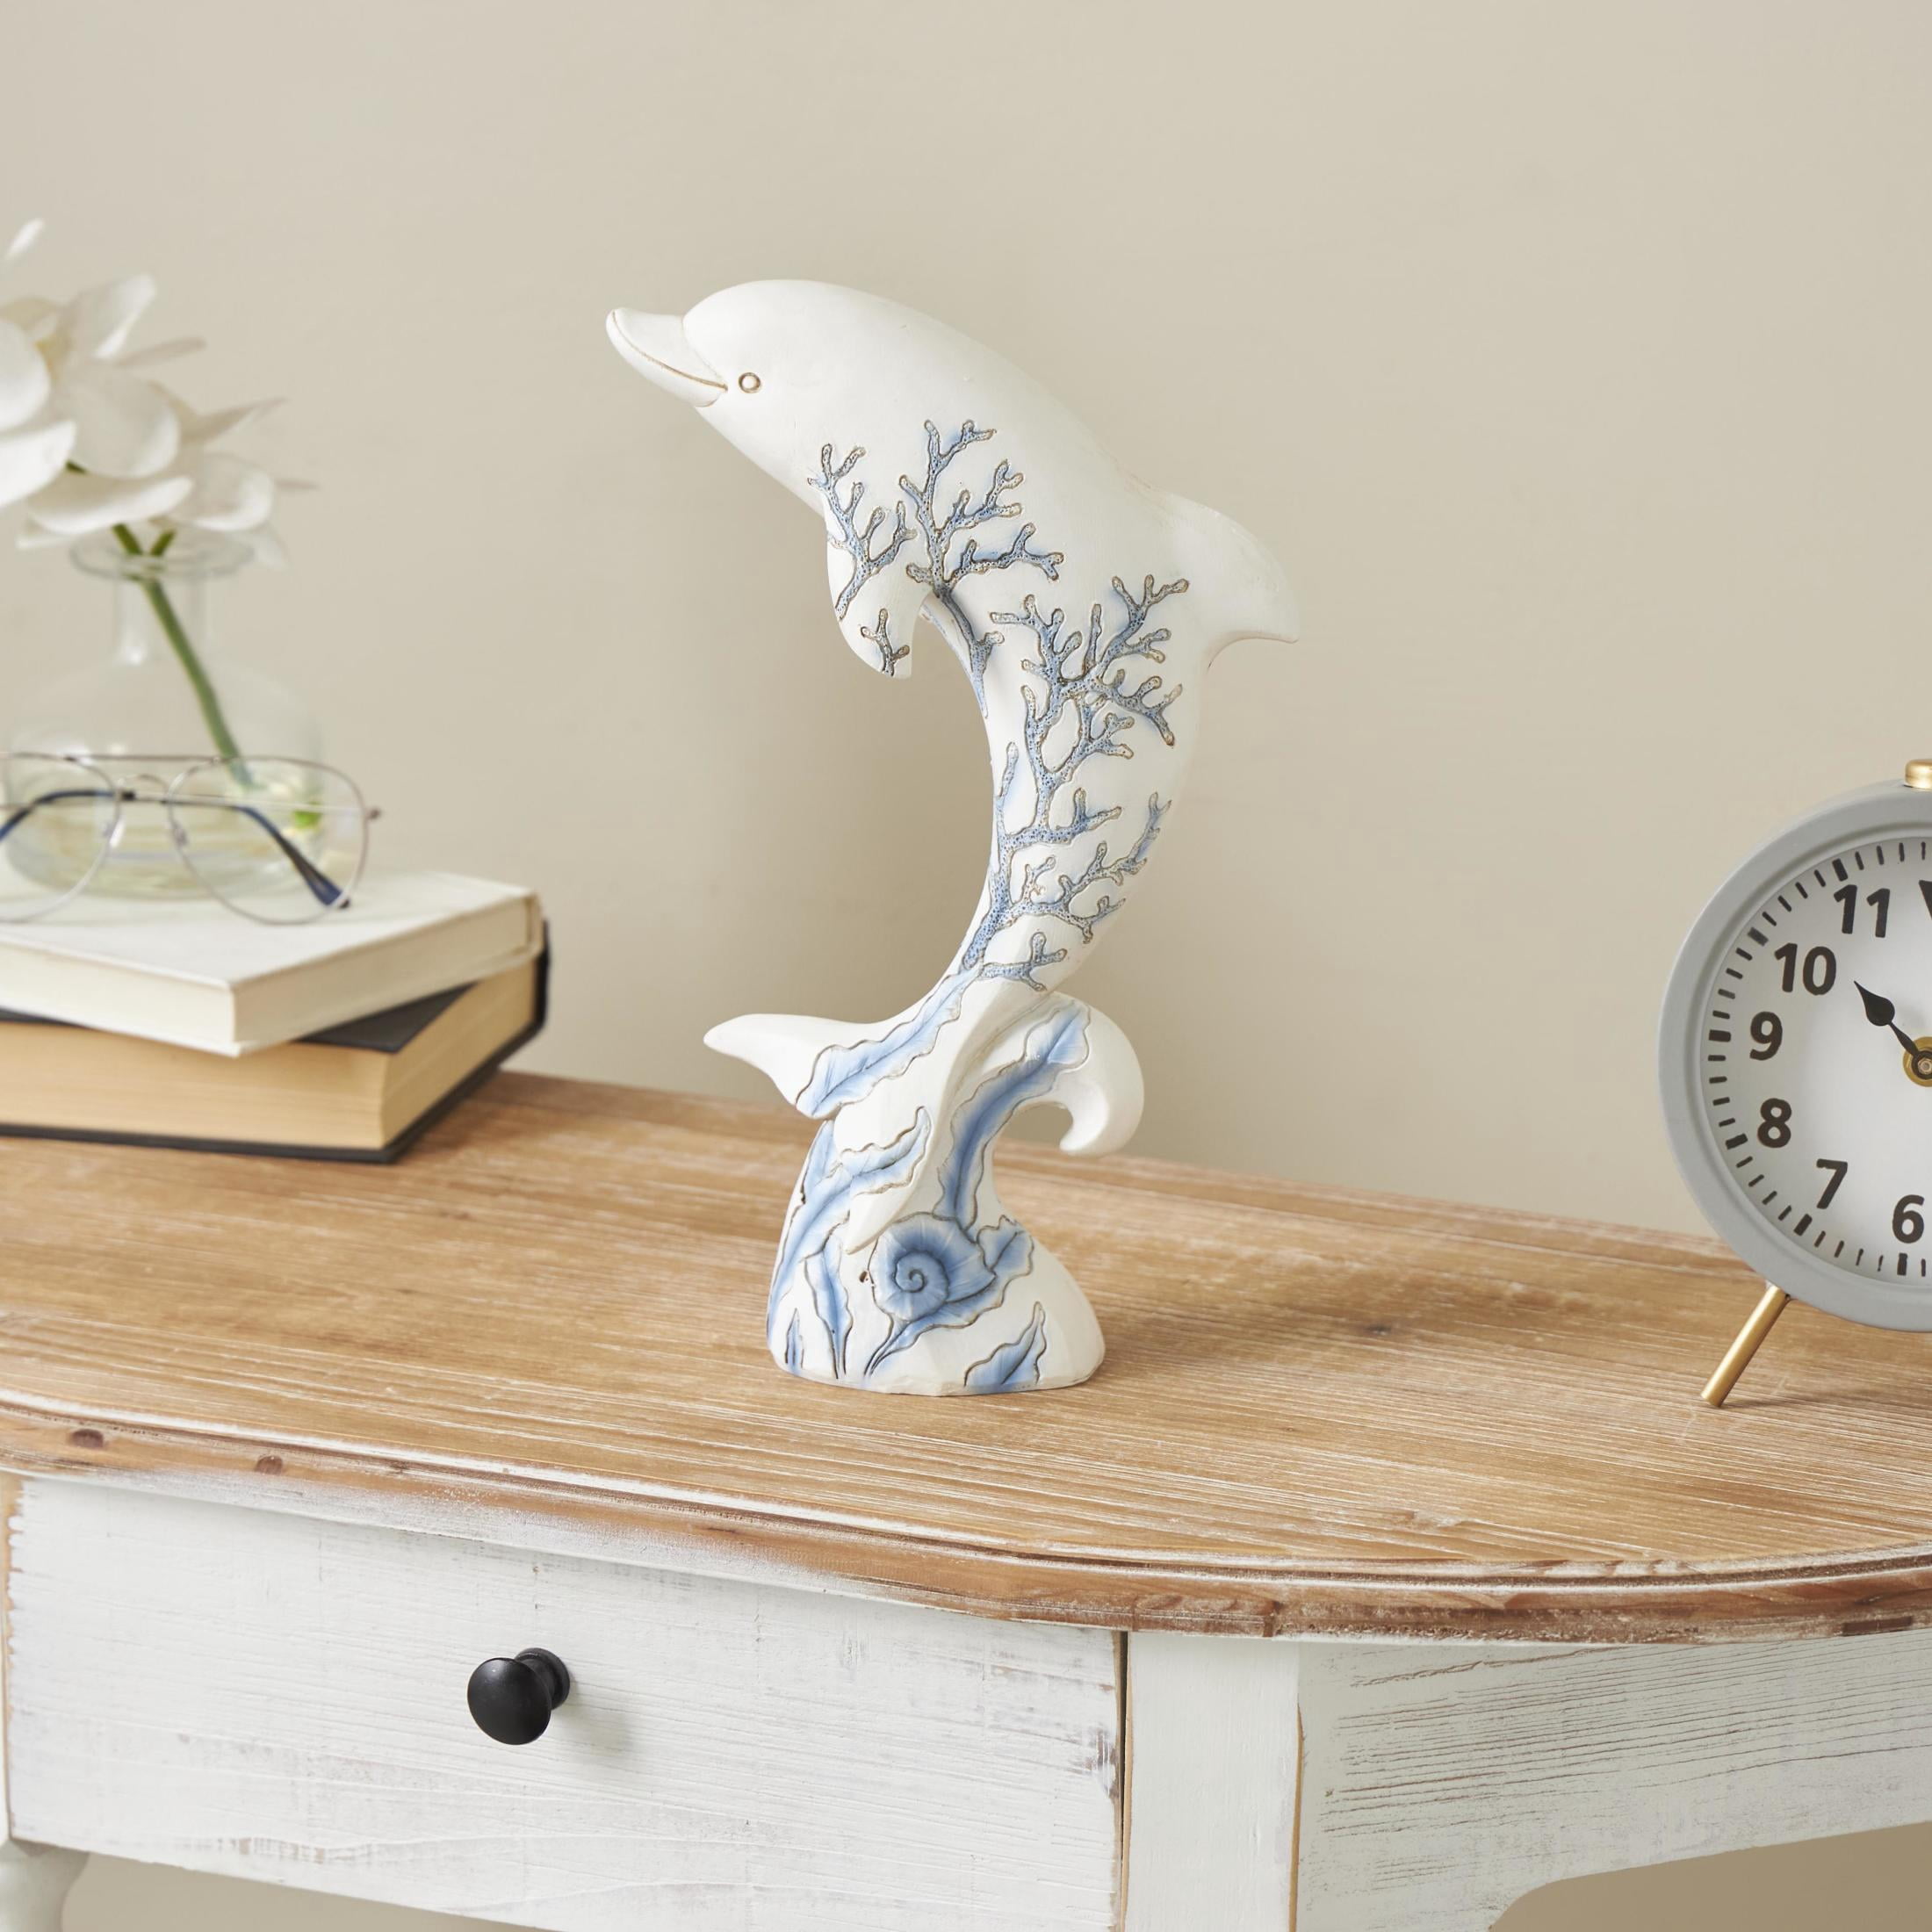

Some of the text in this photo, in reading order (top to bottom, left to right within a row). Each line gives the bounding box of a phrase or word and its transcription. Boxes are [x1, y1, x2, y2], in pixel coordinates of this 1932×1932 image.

[1833, 883, 1891, 939] 11
[1773, 941, 1837, 997] 10
[1748, 1011, 1784, 1062] 9
[1756, 1097, 1792, 1149] 8
[1815, 1158, 1849, 1210] 7
[1892, 1194, 1925, 1244] 6
